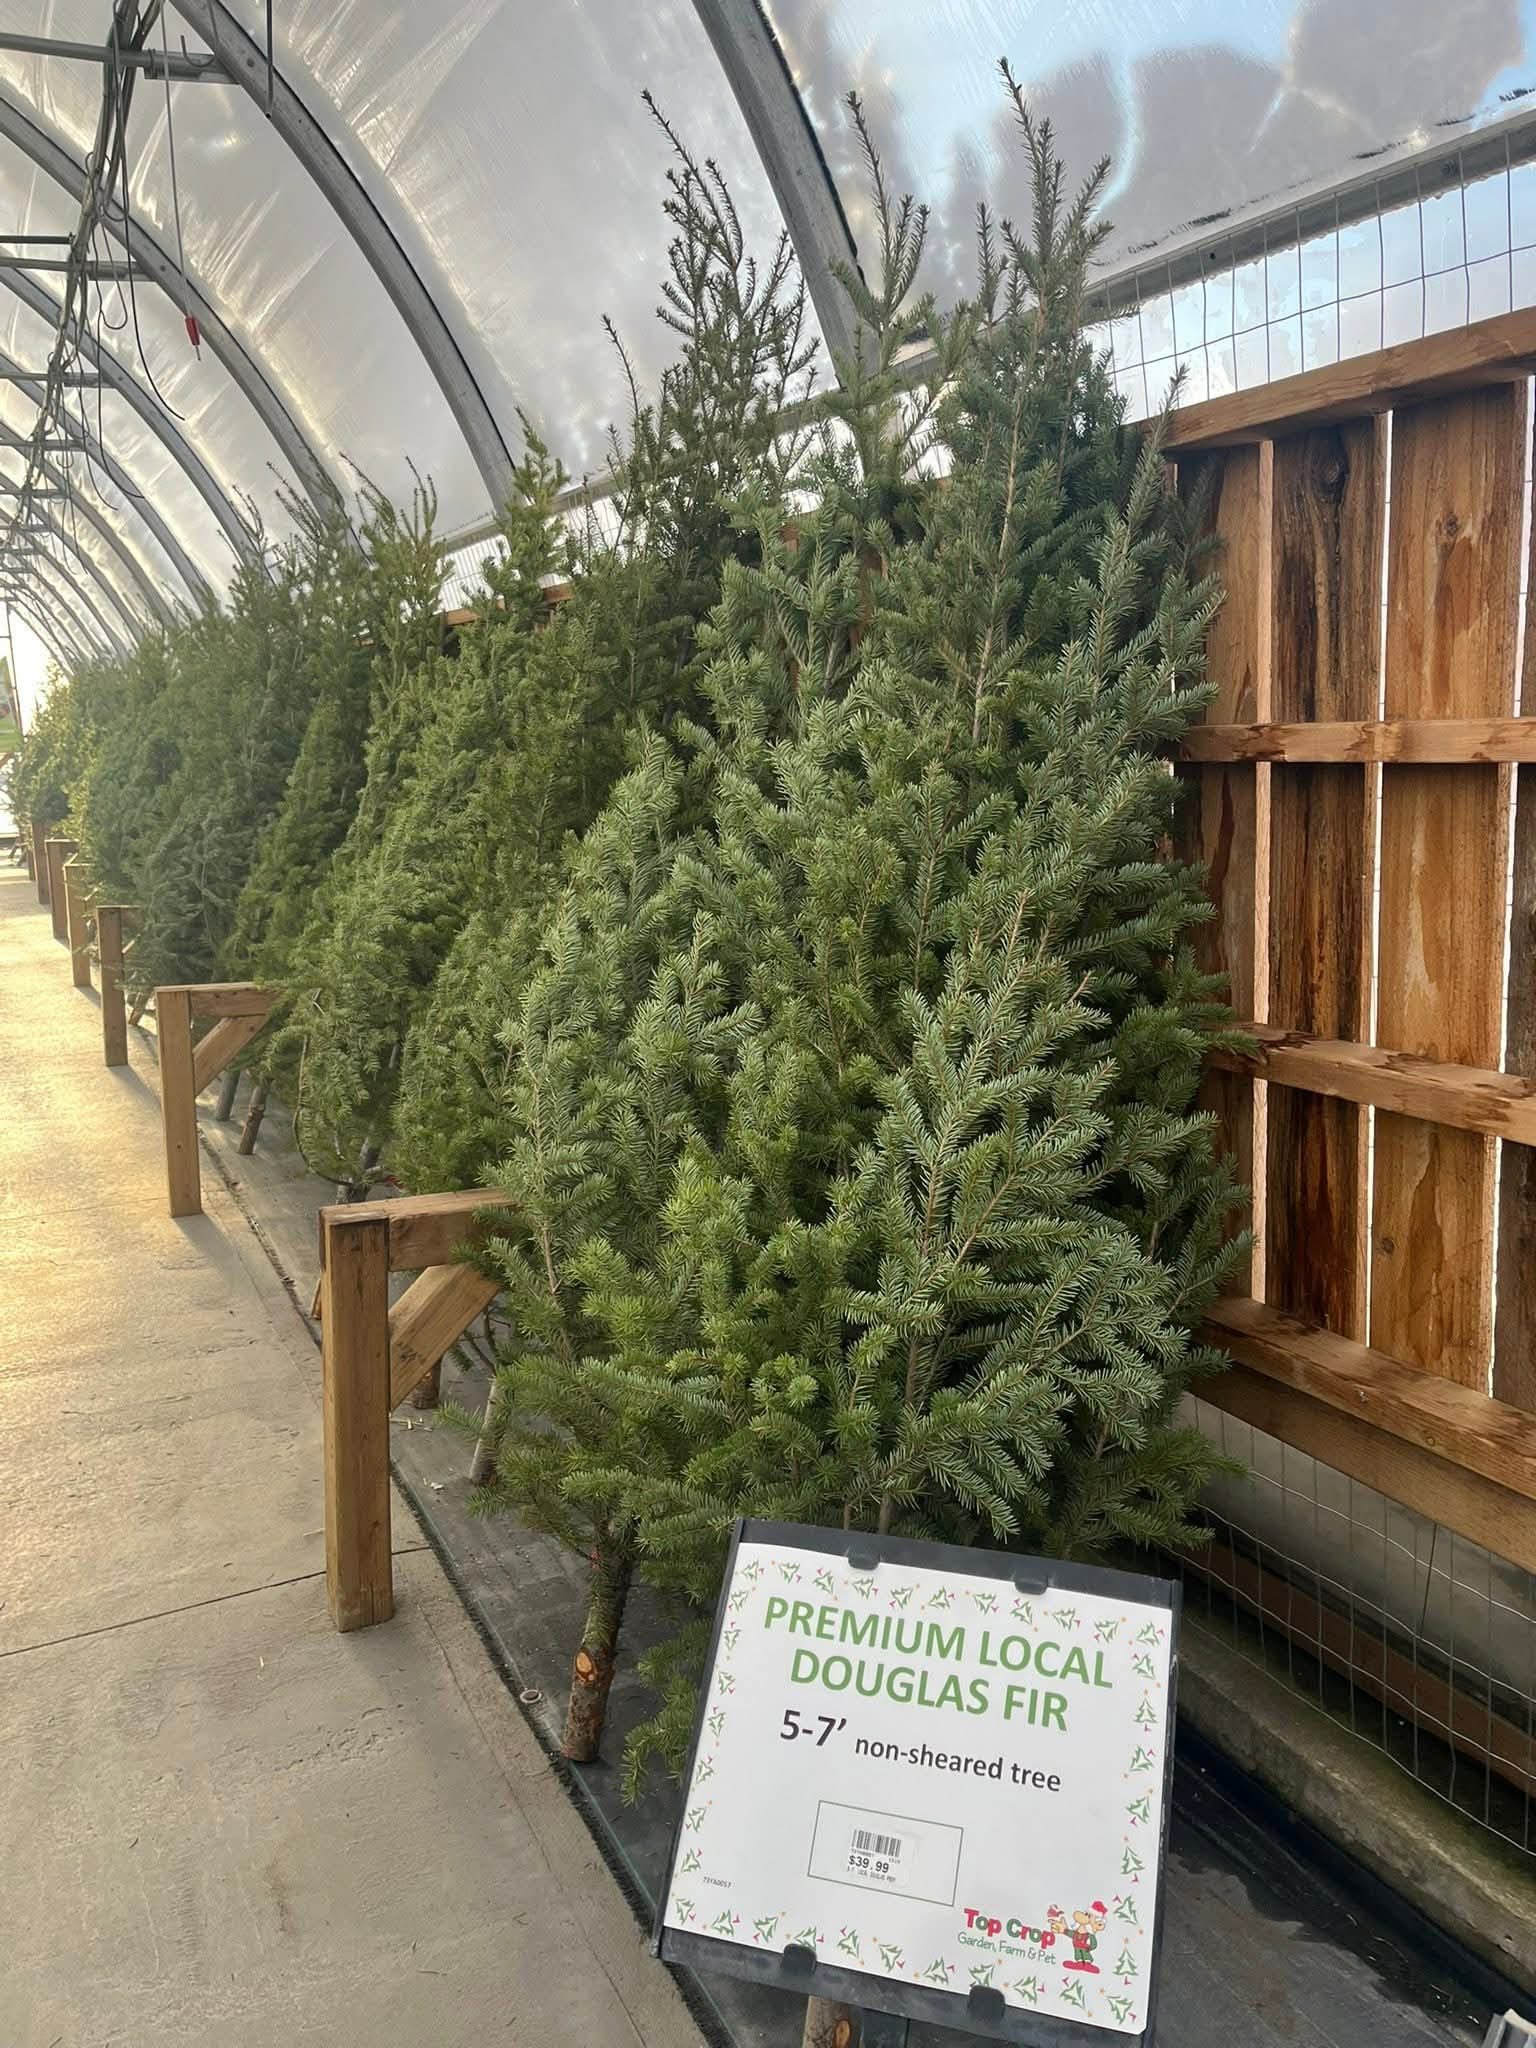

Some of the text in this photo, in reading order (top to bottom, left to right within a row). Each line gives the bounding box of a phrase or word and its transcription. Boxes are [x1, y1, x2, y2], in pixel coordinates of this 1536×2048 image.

[765, 1597, 1113, 1689] PREMIUM LOCAL
[790, 1649, 1068, 1731] DOUGLAS FIR
[855, 1738, 1004, 1780] non-sheared
[1010, 1763, 1062, 1793] tree
[848, 1855, 889, 1873] $39.99
[957, 1931, 1057, 1965] Garden, Farm & Pet
[964, 1908, 1056, 1950] Top Crop
